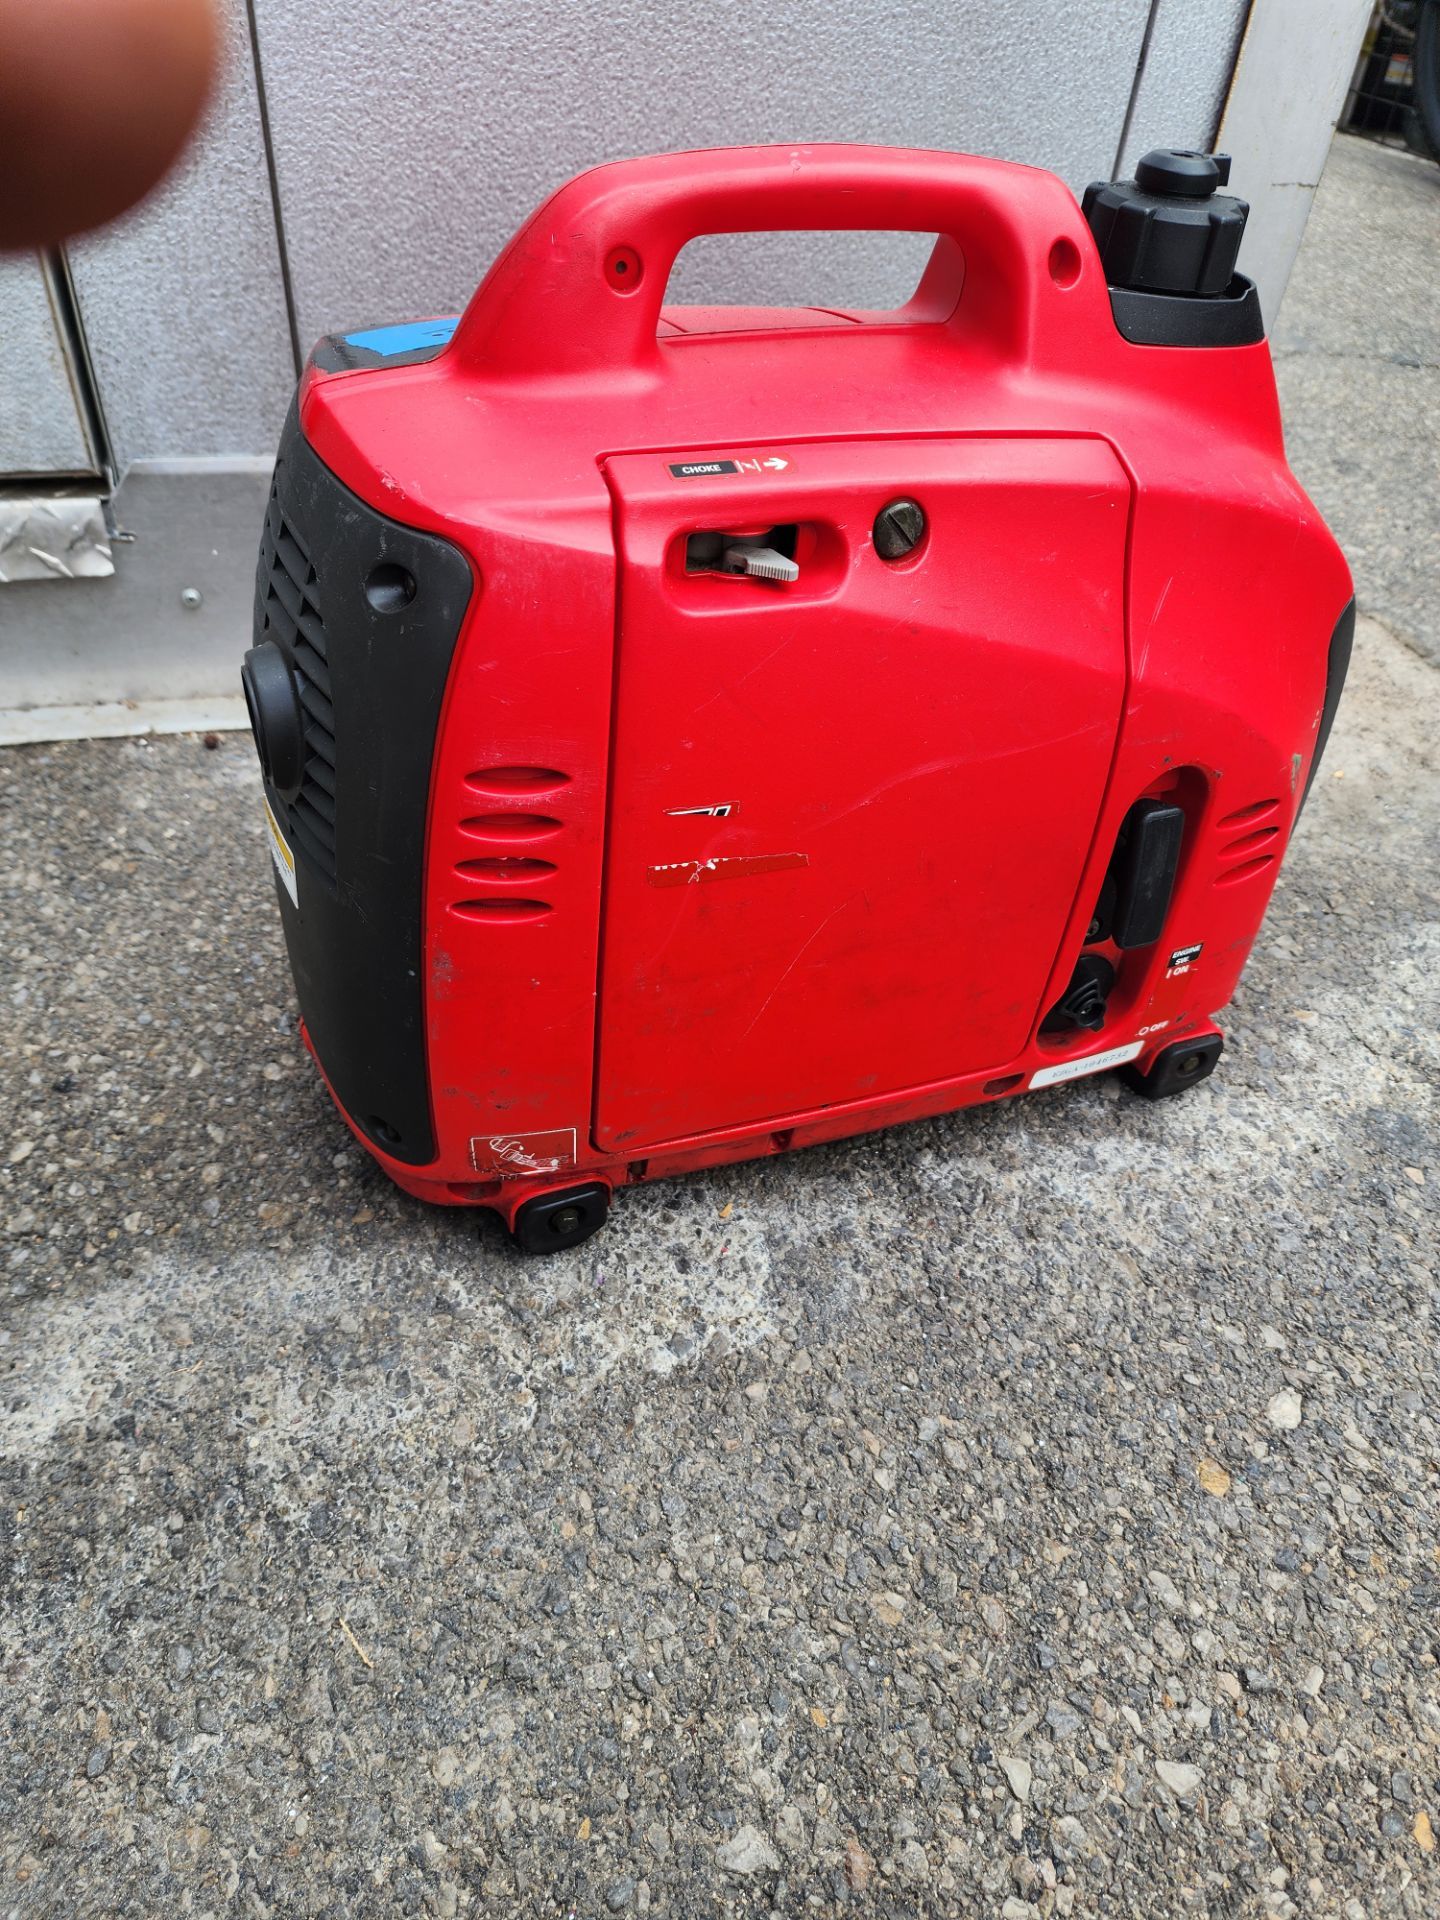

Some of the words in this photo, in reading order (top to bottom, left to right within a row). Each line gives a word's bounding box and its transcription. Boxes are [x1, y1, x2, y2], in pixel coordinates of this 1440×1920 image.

[682, 464, 722, 474] CHOKE
[1172, 944, 1203, 959] ENGINE
[1173, 965, 1190, 976] ON
[1149, 1020, 1169, 1032] OFF
